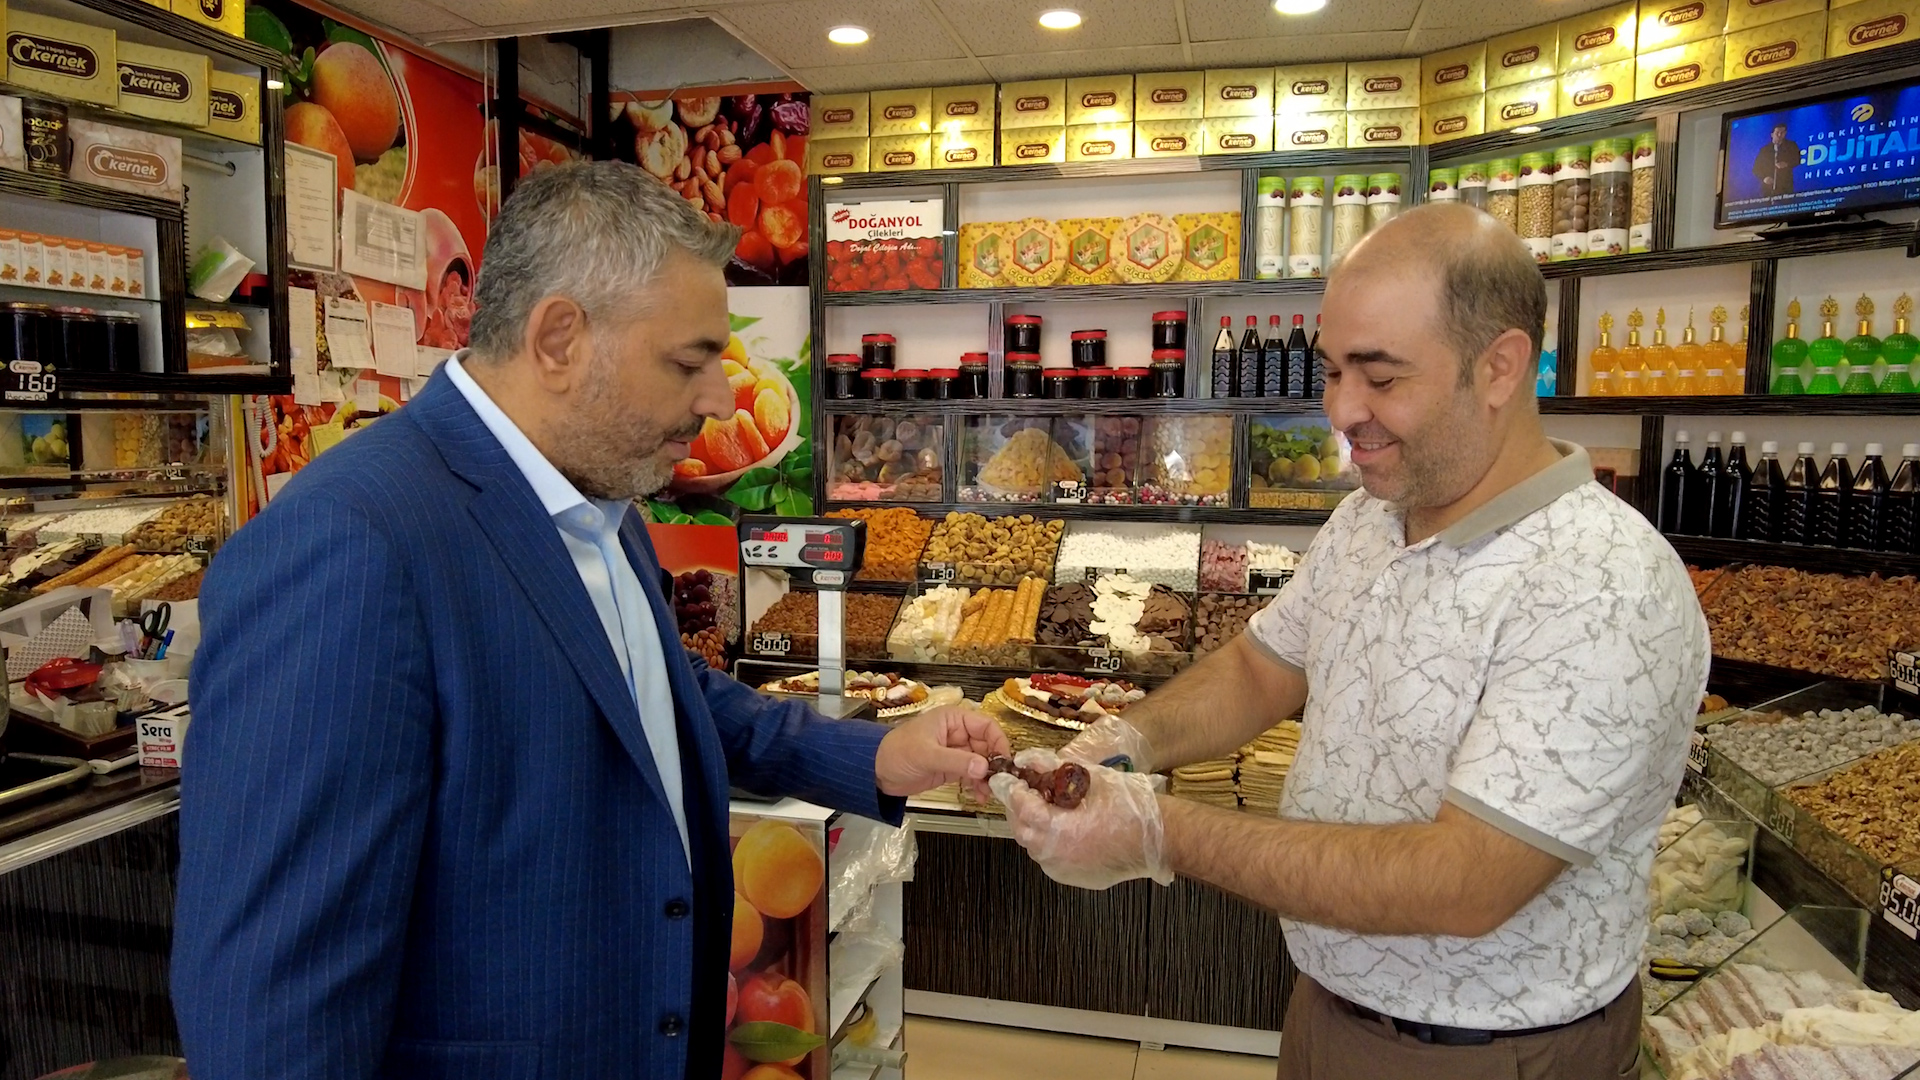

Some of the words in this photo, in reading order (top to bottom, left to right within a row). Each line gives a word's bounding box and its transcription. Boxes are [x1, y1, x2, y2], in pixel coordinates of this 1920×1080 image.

[1863, 181, 1878, 189] 1000
[848, 213, 923, 229] DOĞANYOL
[868, 229, 904, 239] Çilekleri
[19, 373, 56, 393] 160
[1063, 486, 1087, 500] 150
[931, 568, 955, 580] 130
[753, 638, 790, 652] 60.00
[1094, 656, 1120, 670] 120
[141, 723, 172, 737] Sera
[1769, 807, 1795, 840] 200
